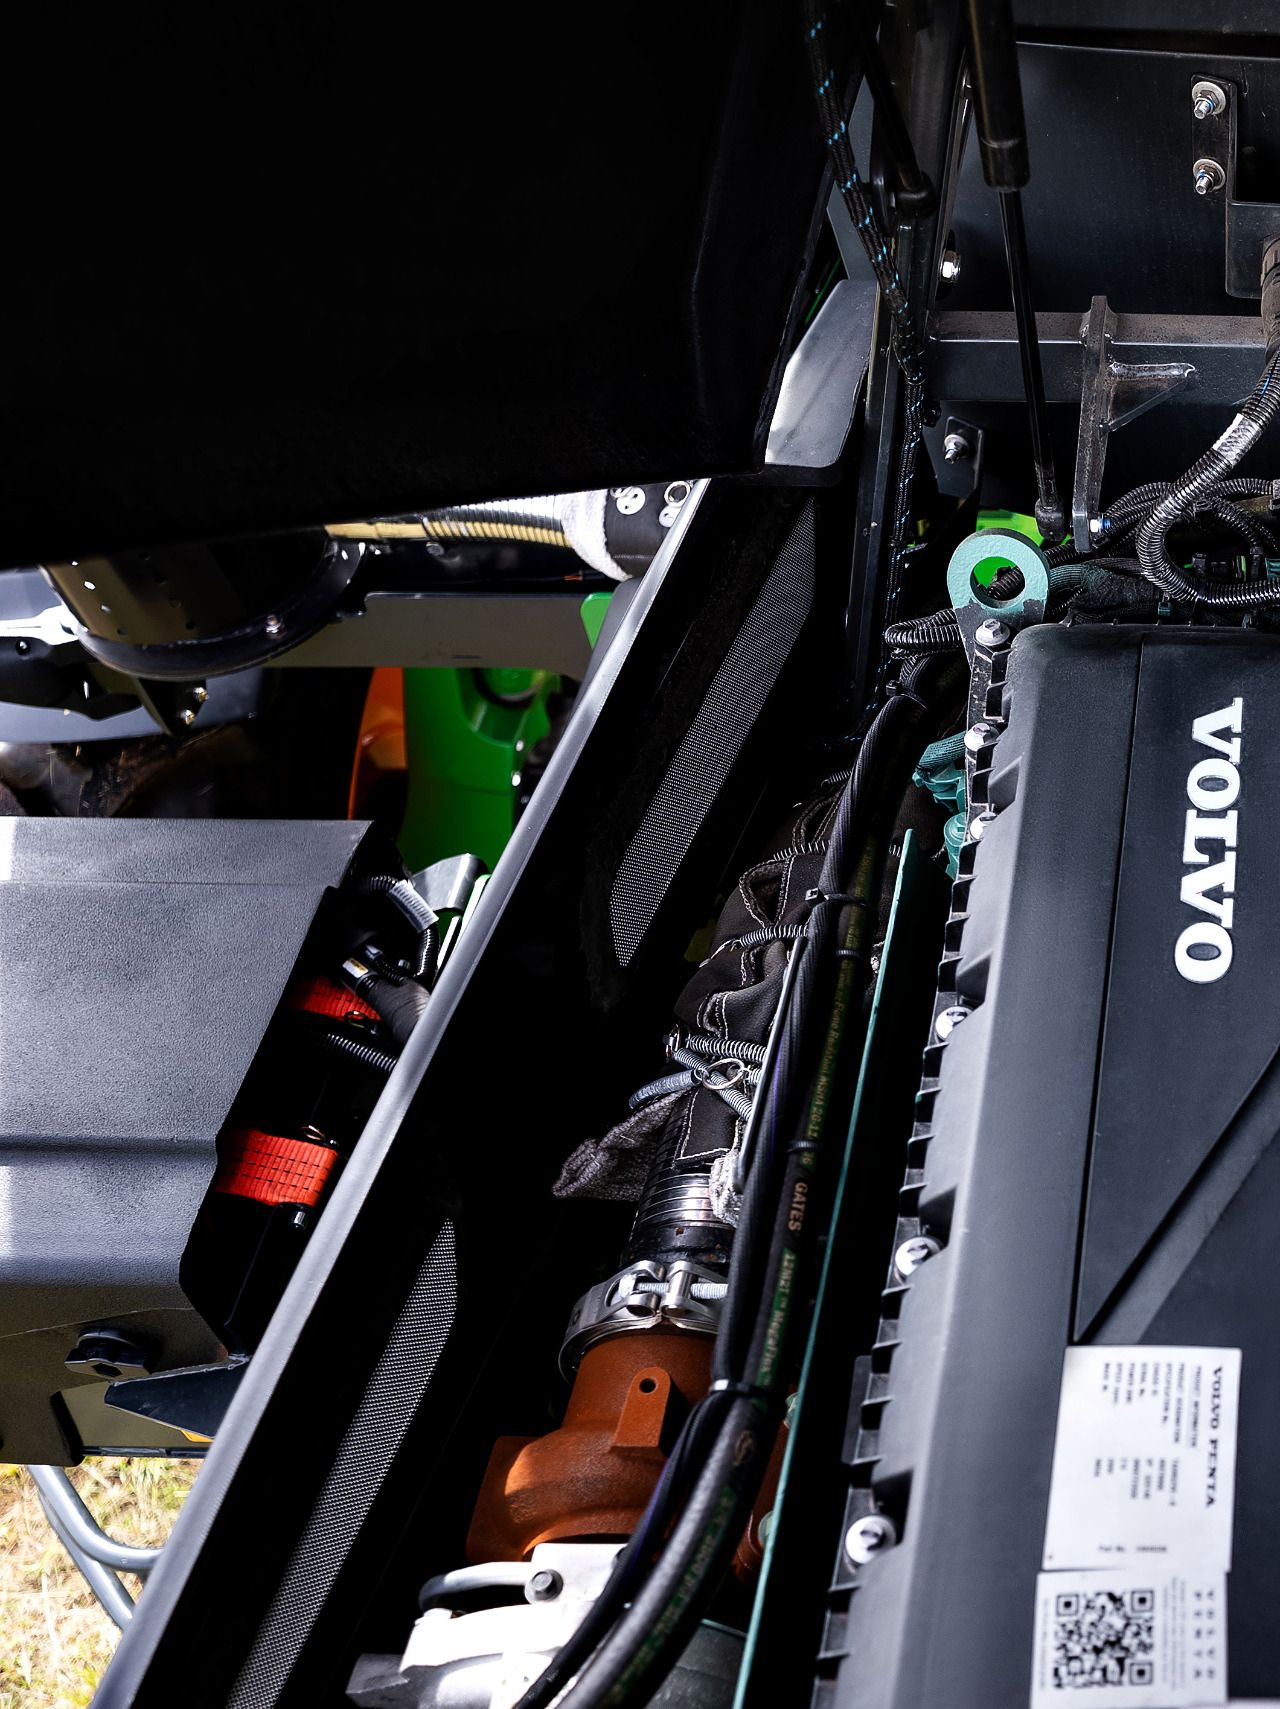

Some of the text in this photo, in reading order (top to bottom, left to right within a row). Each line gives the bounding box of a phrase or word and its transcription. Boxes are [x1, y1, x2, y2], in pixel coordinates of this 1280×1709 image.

[1174, 697, 1243, 984] VOLVO
[788, 1181, 808, 1232] GATES
[1205, 1365, 1223, 1508] VOLVO PENTA
